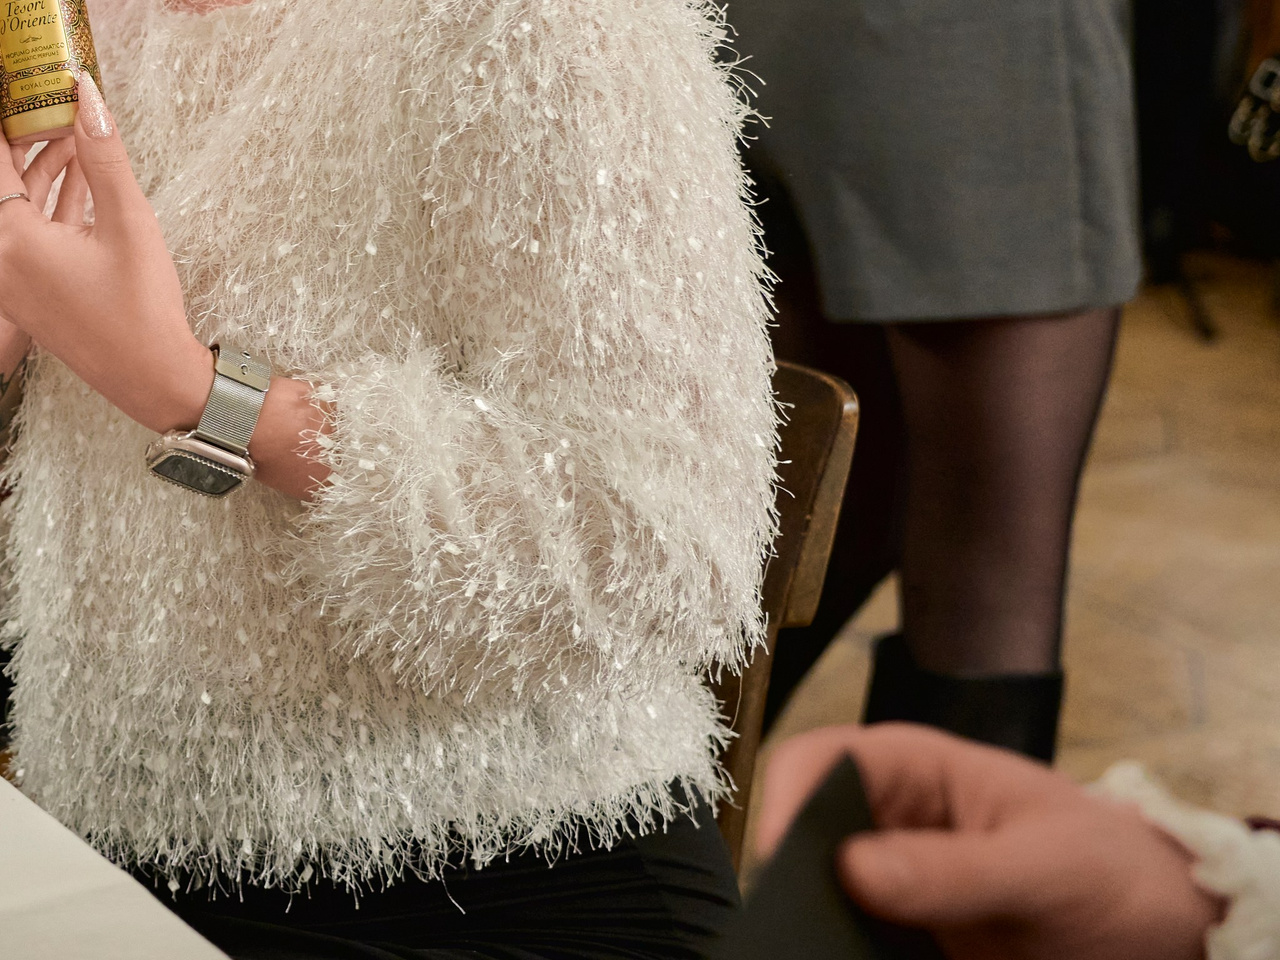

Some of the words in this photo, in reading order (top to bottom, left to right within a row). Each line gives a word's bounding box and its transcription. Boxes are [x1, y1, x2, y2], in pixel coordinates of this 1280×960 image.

[0, 13, 58, 35] d'Oriente
[5, 49, 30, 59] PROFUMO
[31, 42, 65, 53] AROMATICO
[12, 54, 37, 65] AROMATIC
[37, 50, 59, 58] PERFUME
[20, 82, 42, 92] ROYAL
[44, 78, 62, 86] OUD
